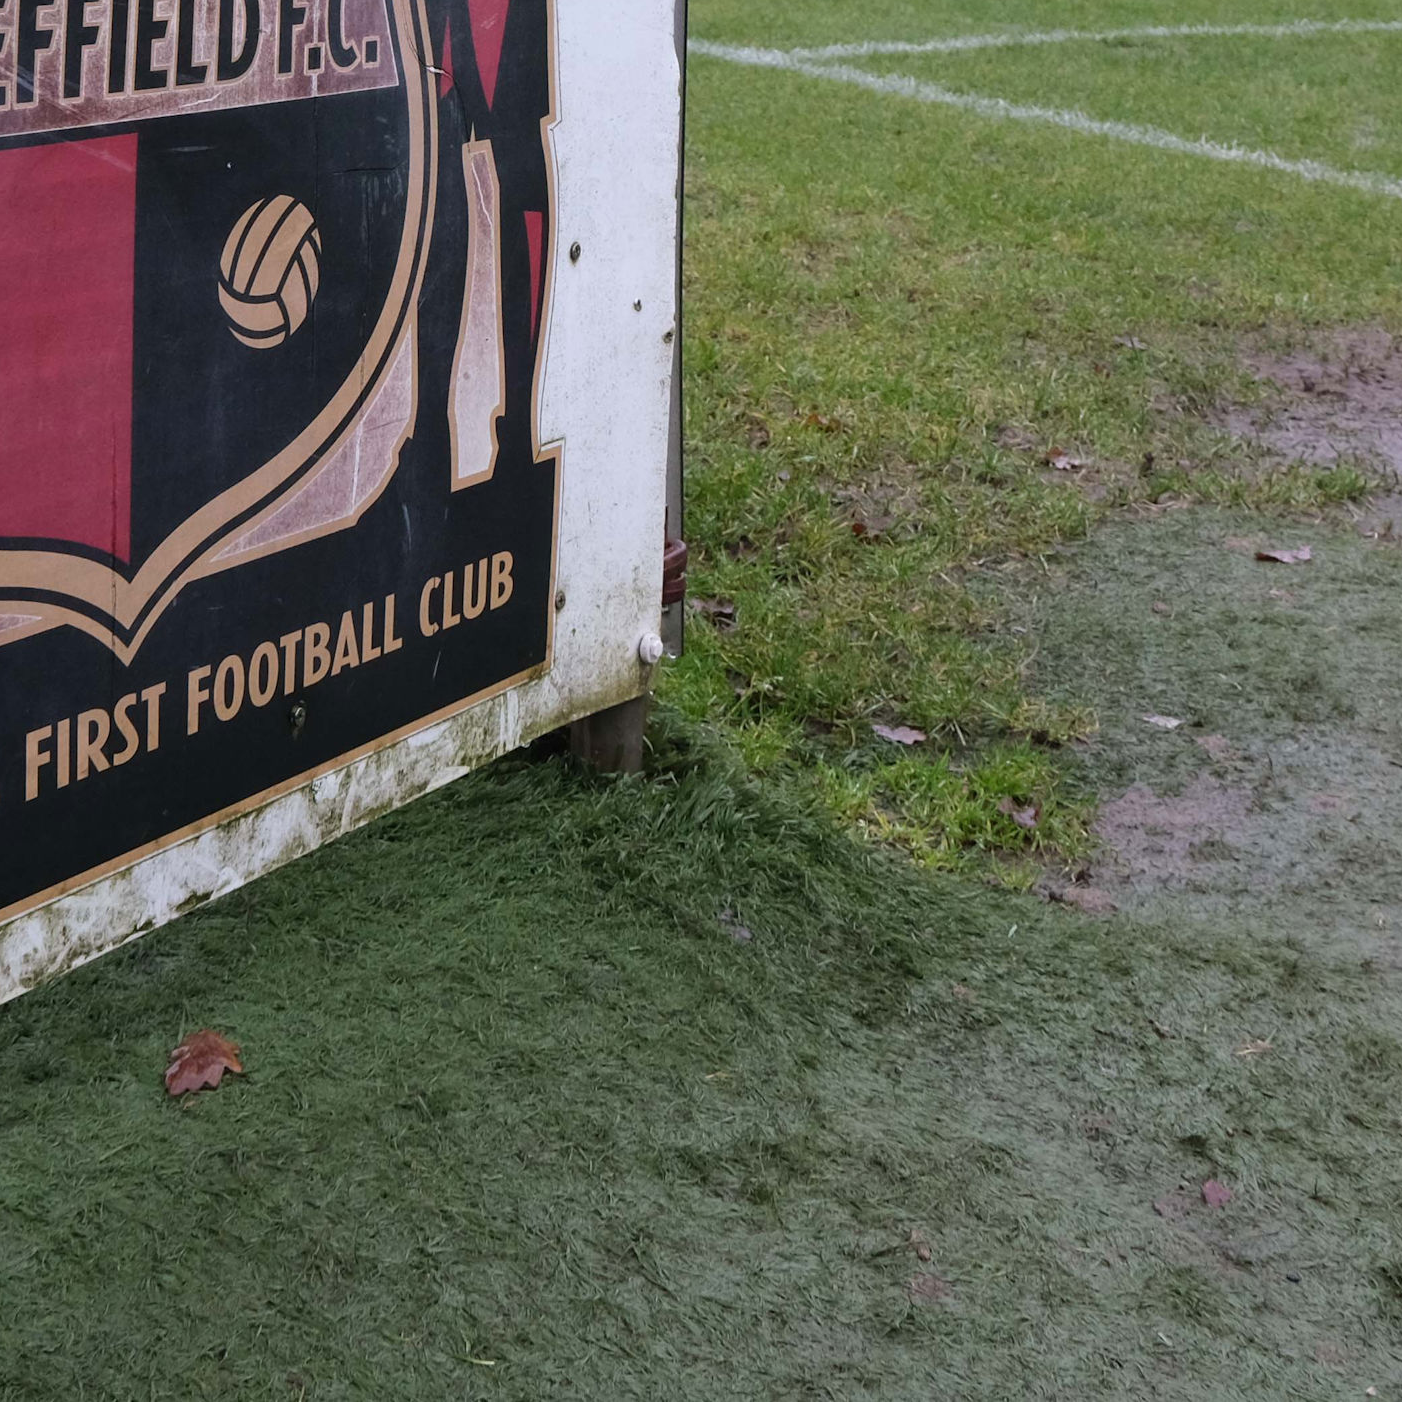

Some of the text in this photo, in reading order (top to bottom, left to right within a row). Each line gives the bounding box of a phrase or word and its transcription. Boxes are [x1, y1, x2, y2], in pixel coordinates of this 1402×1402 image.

[22, 681, 167, 802] FIRST
[185, 592, 404, 737] FOOTBALL
[418, 549, 515, 638] CLUB
